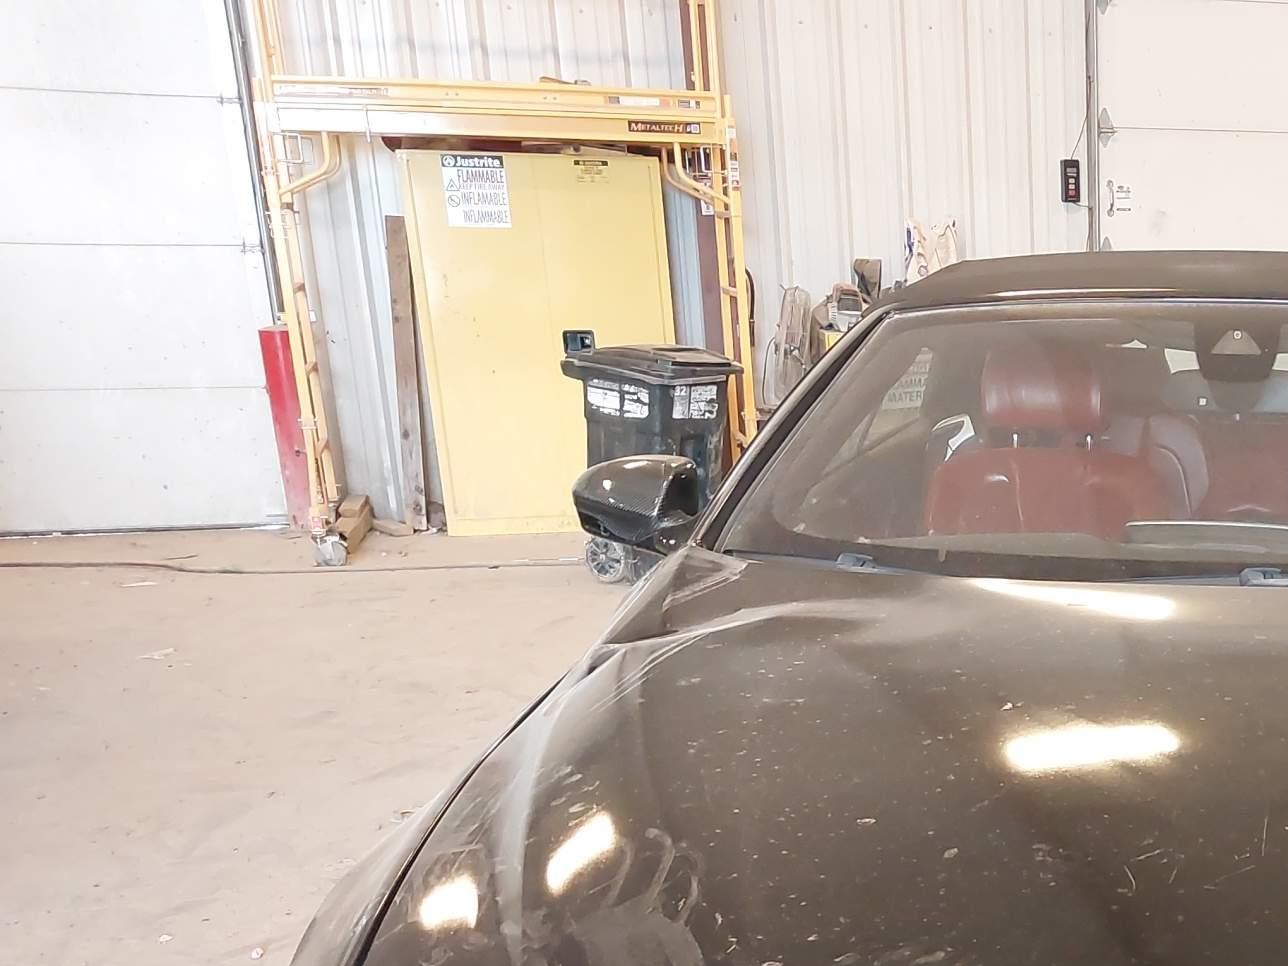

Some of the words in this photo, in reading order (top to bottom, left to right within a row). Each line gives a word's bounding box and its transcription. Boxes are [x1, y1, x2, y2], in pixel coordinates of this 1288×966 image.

[630, 122, 683, 133] METALTECH
[456, 156, 500, 168] Justrite
[457, 169, 504, 184] FLAMMABLE
[461, 192, 507, 206] INFLAMABLE
